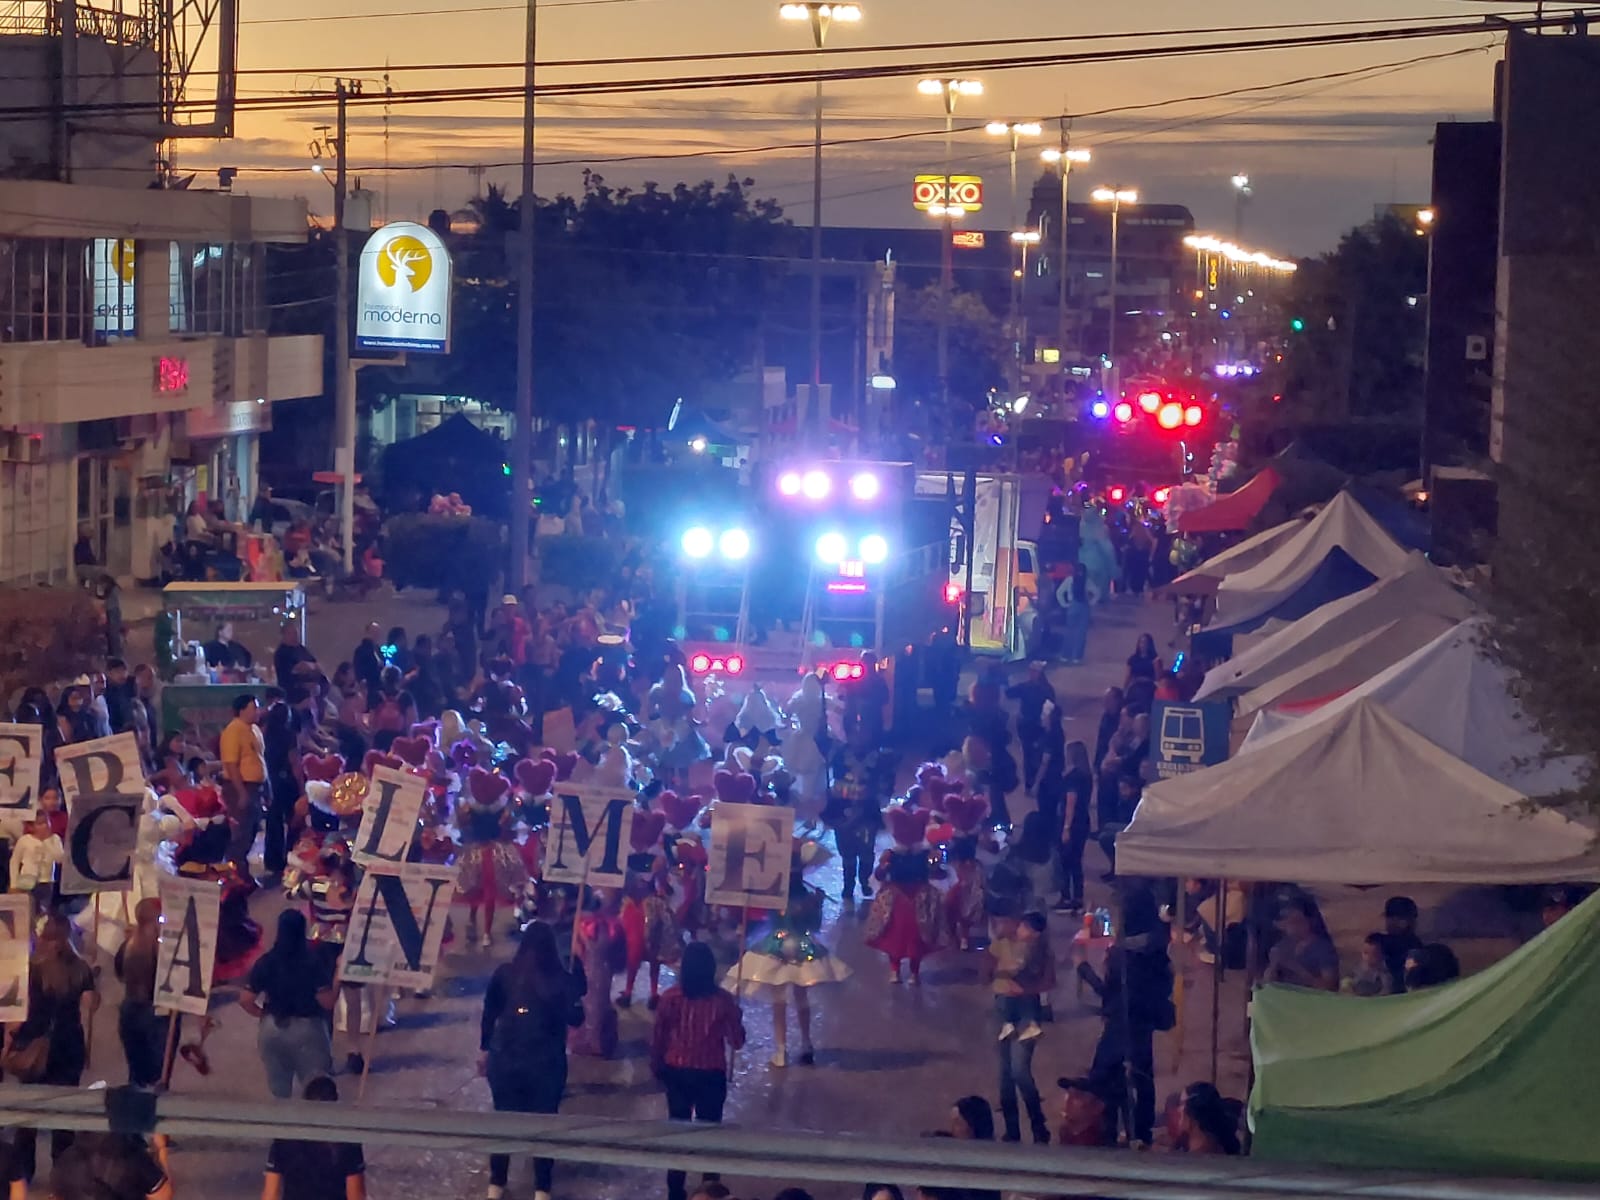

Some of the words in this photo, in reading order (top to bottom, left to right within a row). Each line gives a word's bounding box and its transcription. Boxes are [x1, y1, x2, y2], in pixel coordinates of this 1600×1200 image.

[916, 183, 980, 203] OXXO
[364, 308, 441, 325] moderna
[71, 804, 137, 882] C
[360, 779, 408, 861] L
[550, 794, 632, 875] M
[713, 817, 784, 897] E
[159, 895, 207, 999] A
[347, 873, 449, 971] N
